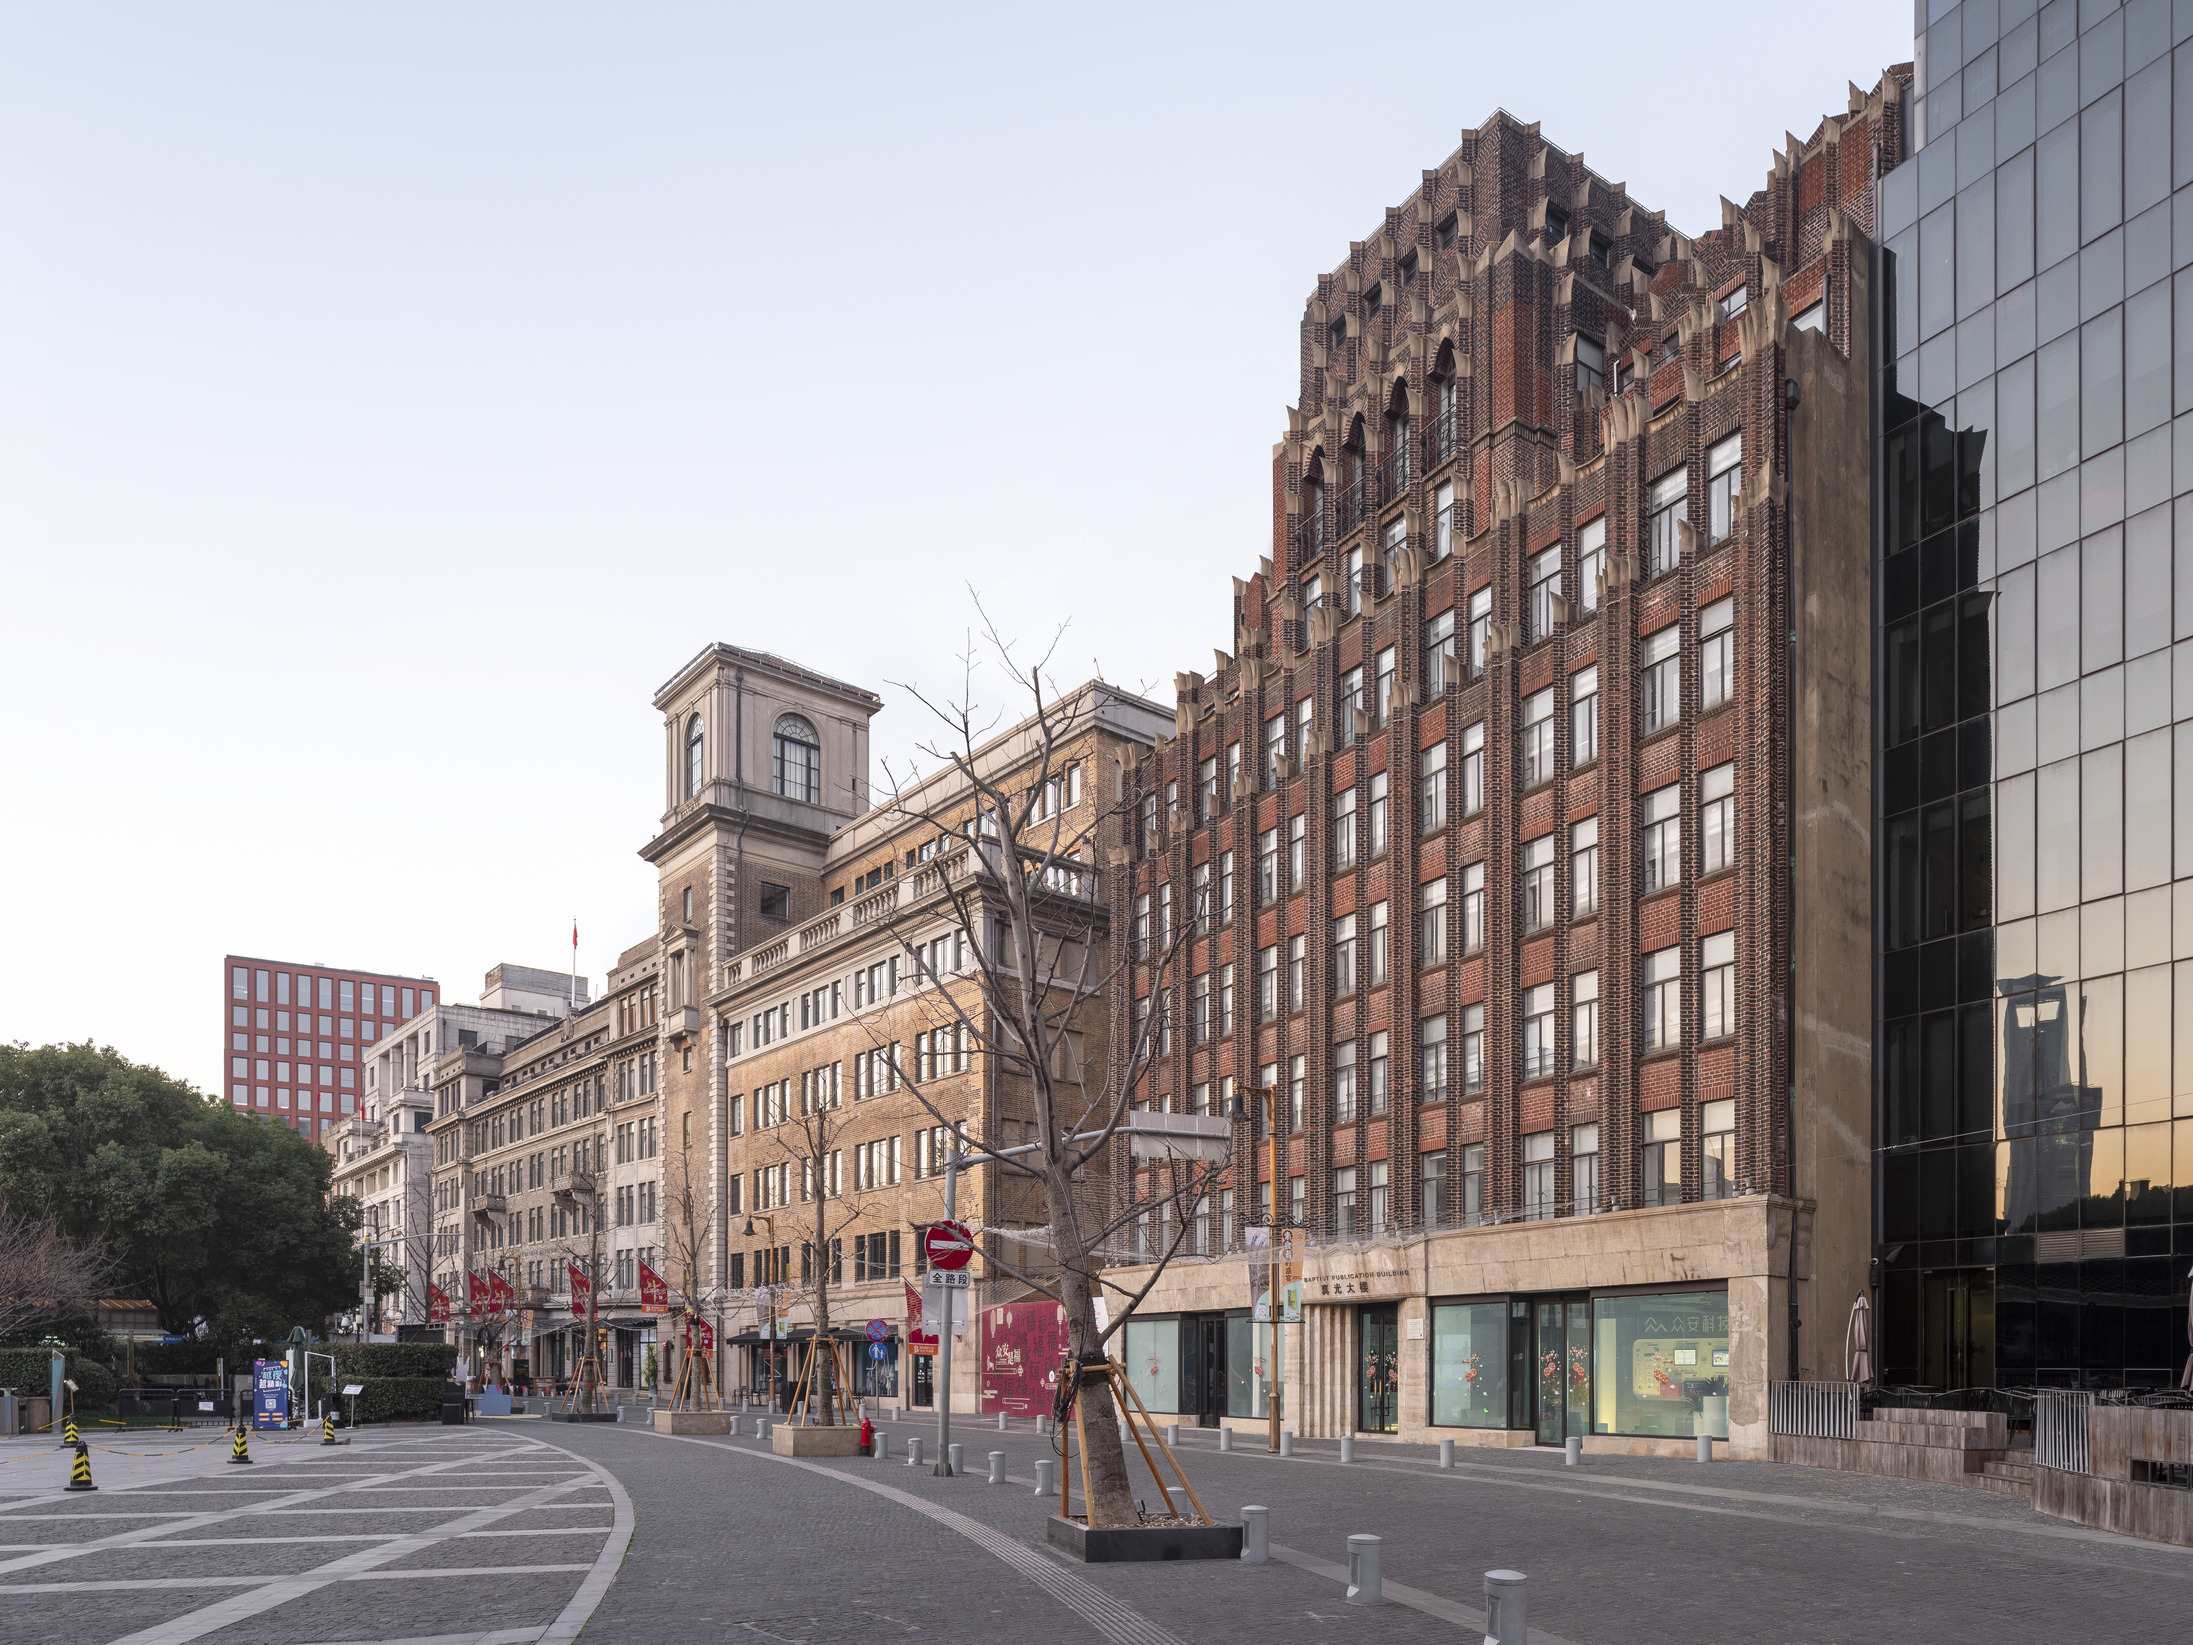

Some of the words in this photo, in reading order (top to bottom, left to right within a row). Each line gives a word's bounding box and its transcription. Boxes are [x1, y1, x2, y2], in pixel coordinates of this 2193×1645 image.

[932, 1272, 968, 1285] 全路段
[1304, 1275, 1329, 1283] BAPTIST
[1332, 1271, 1375, 1281] PUBLICATION
[1376, 1269, 1410, 1278] BUILDING
